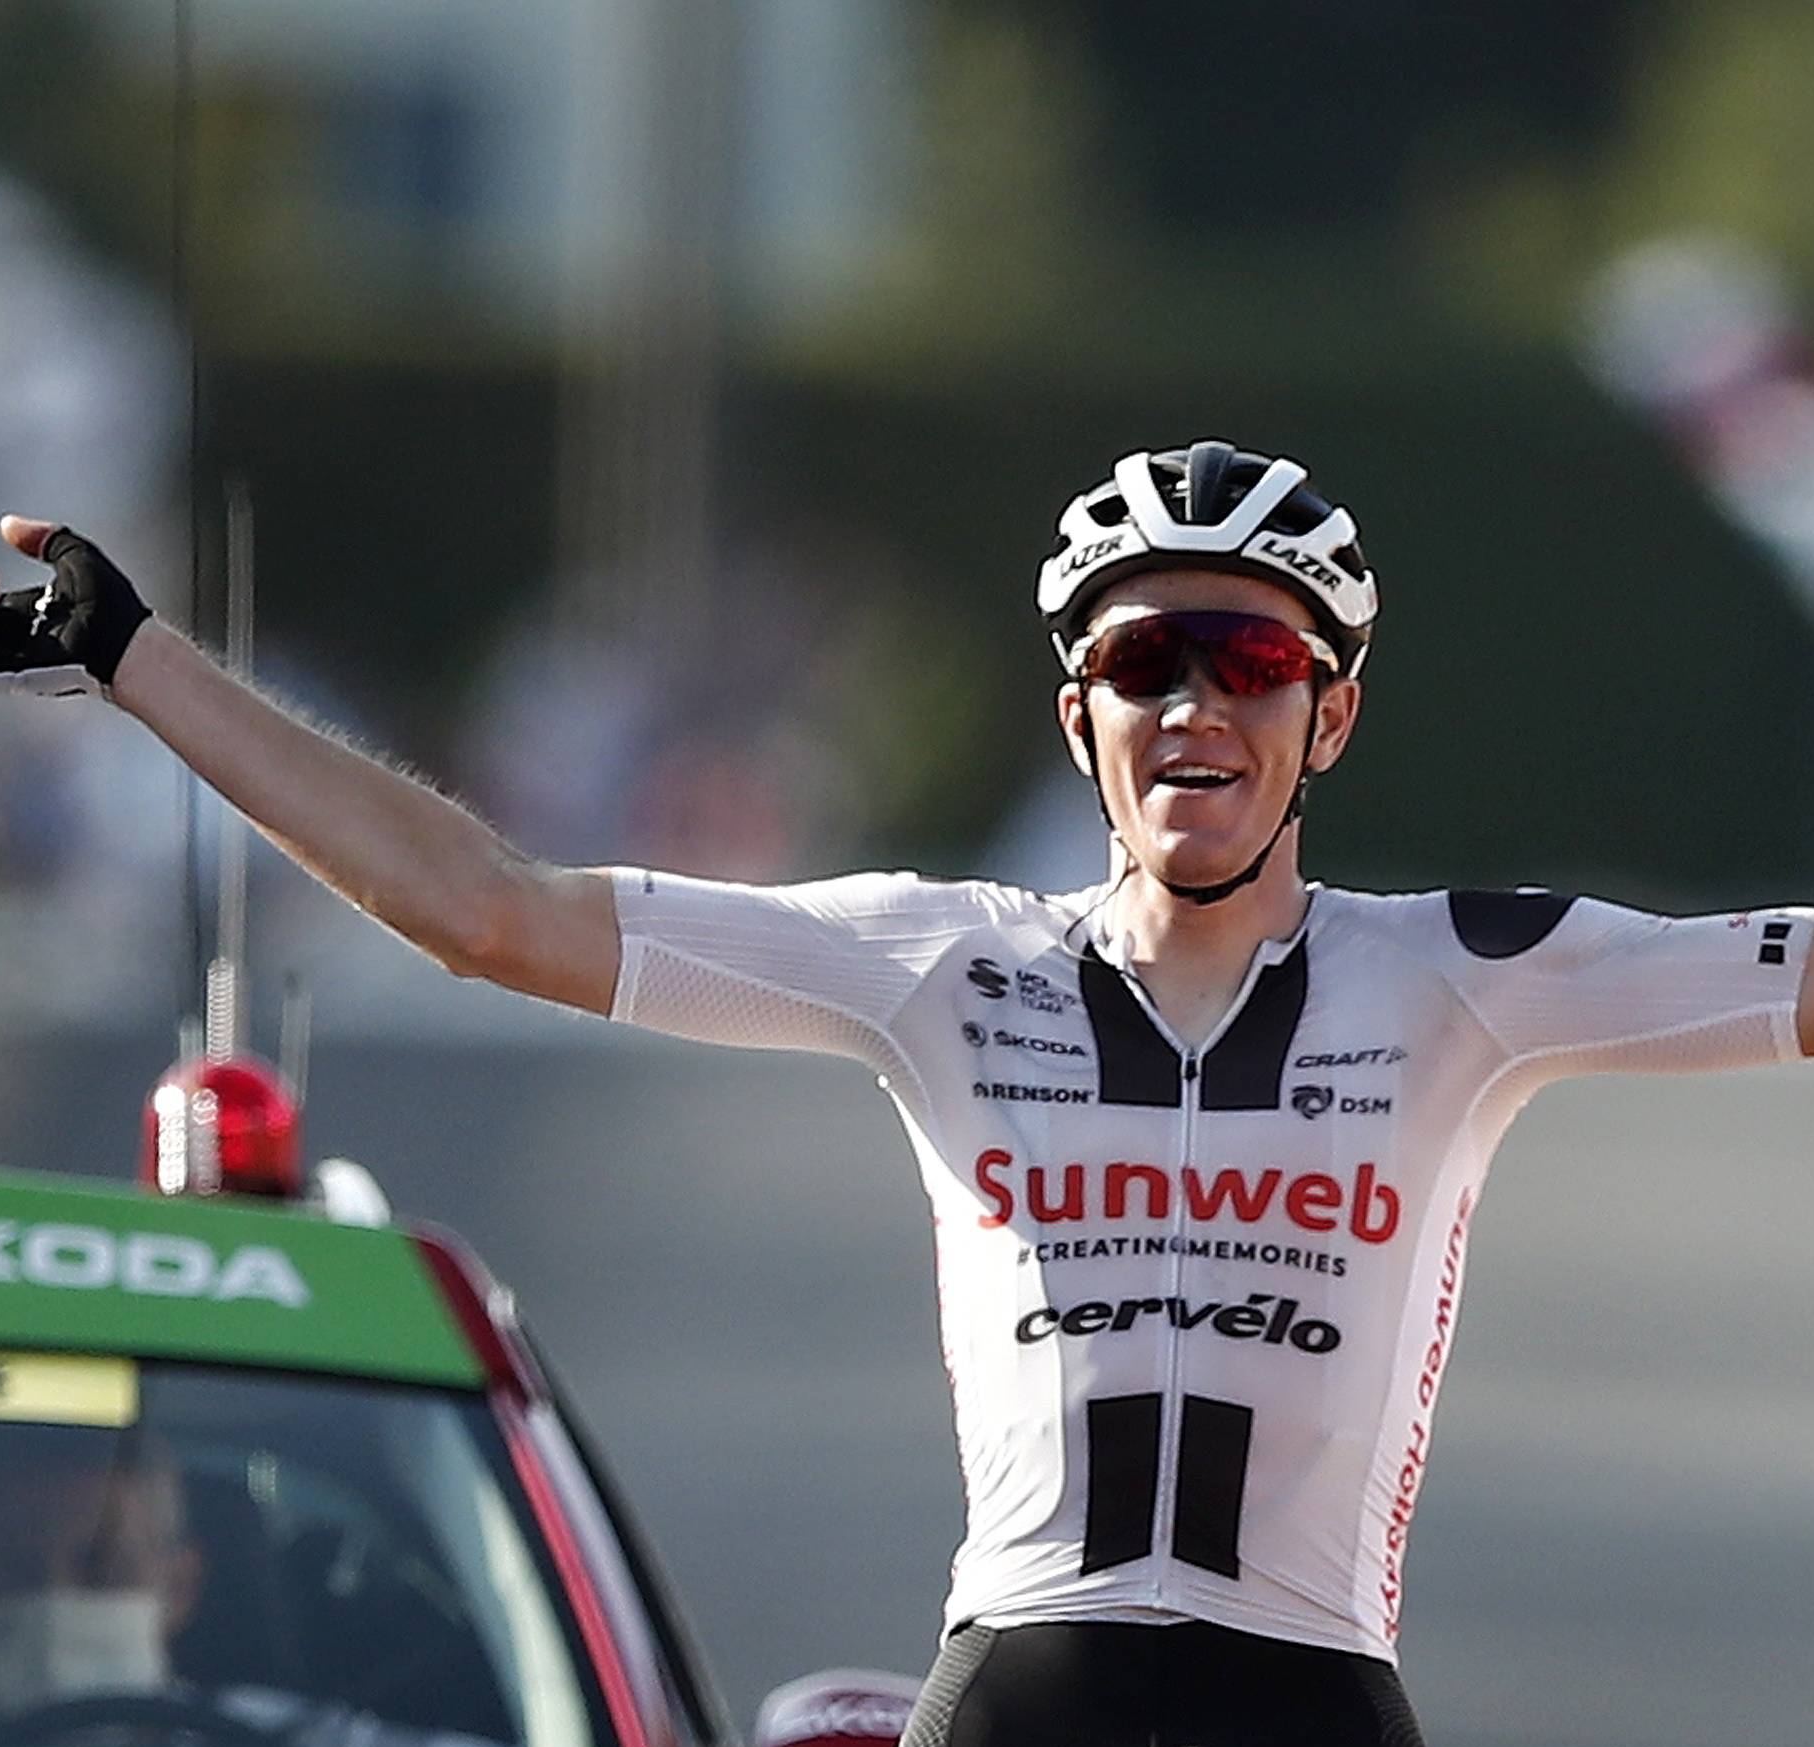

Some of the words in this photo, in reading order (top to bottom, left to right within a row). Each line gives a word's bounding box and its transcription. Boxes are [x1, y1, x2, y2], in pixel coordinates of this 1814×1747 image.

[1059, 534, 1125, 581] LAZER
[1261, 538, 1343, 592] LAZER
[1294, 1049, 1387, 1068] CRAFT
[992, 1082, 1090, 1103] RENSON
[1340, 1098, 1391, 1114] DSM
[974, 1148, 1401, 1245] Sunweb
[1015, 1293, 1341, 1354] cervélo
